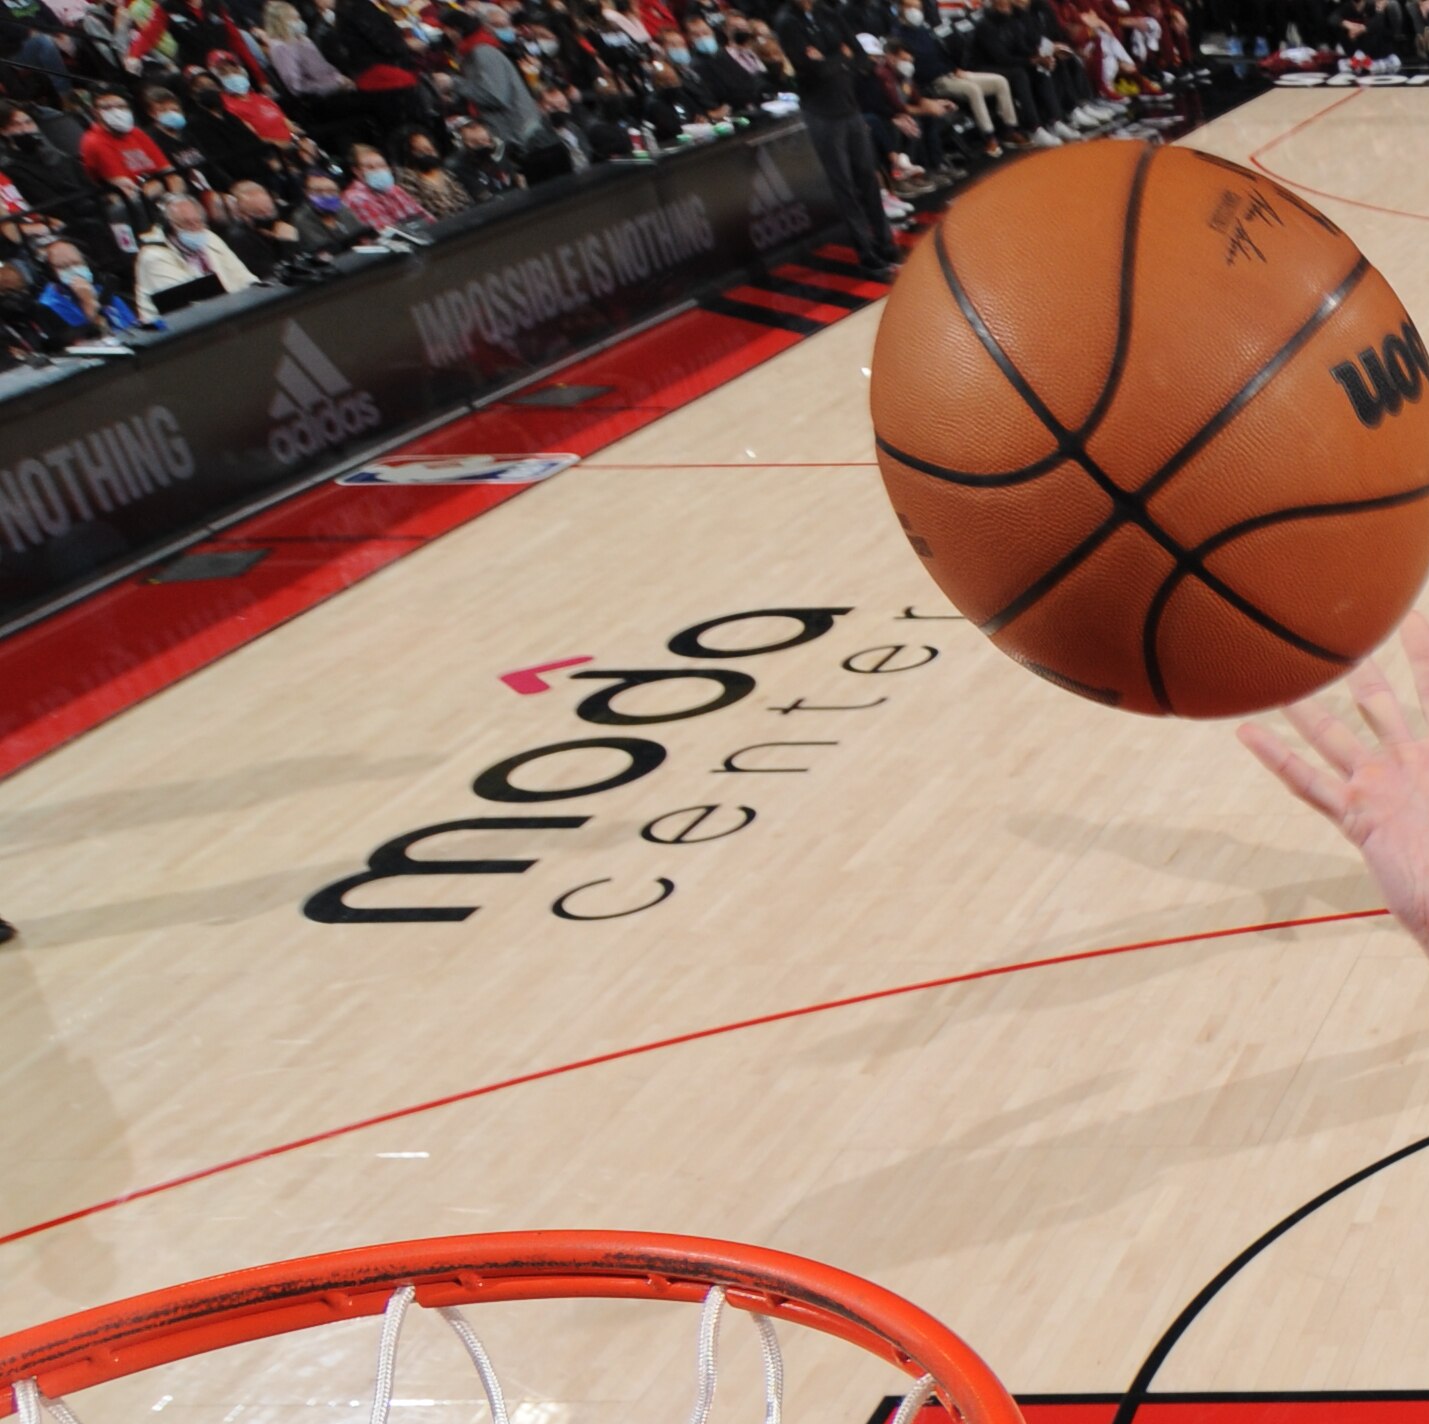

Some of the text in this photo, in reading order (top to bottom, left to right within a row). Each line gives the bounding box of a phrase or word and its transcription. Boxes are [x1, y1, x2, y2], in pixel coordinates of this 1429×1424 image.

[411, 194, 716, 367] IMPOSSIBLE IS NOTHING
[0, 404, 195, 552] NOTHING
[268, 390, 382, 465] adidas
[303, 606, 855, 925] moda
[552, 606, 966, 922] center
